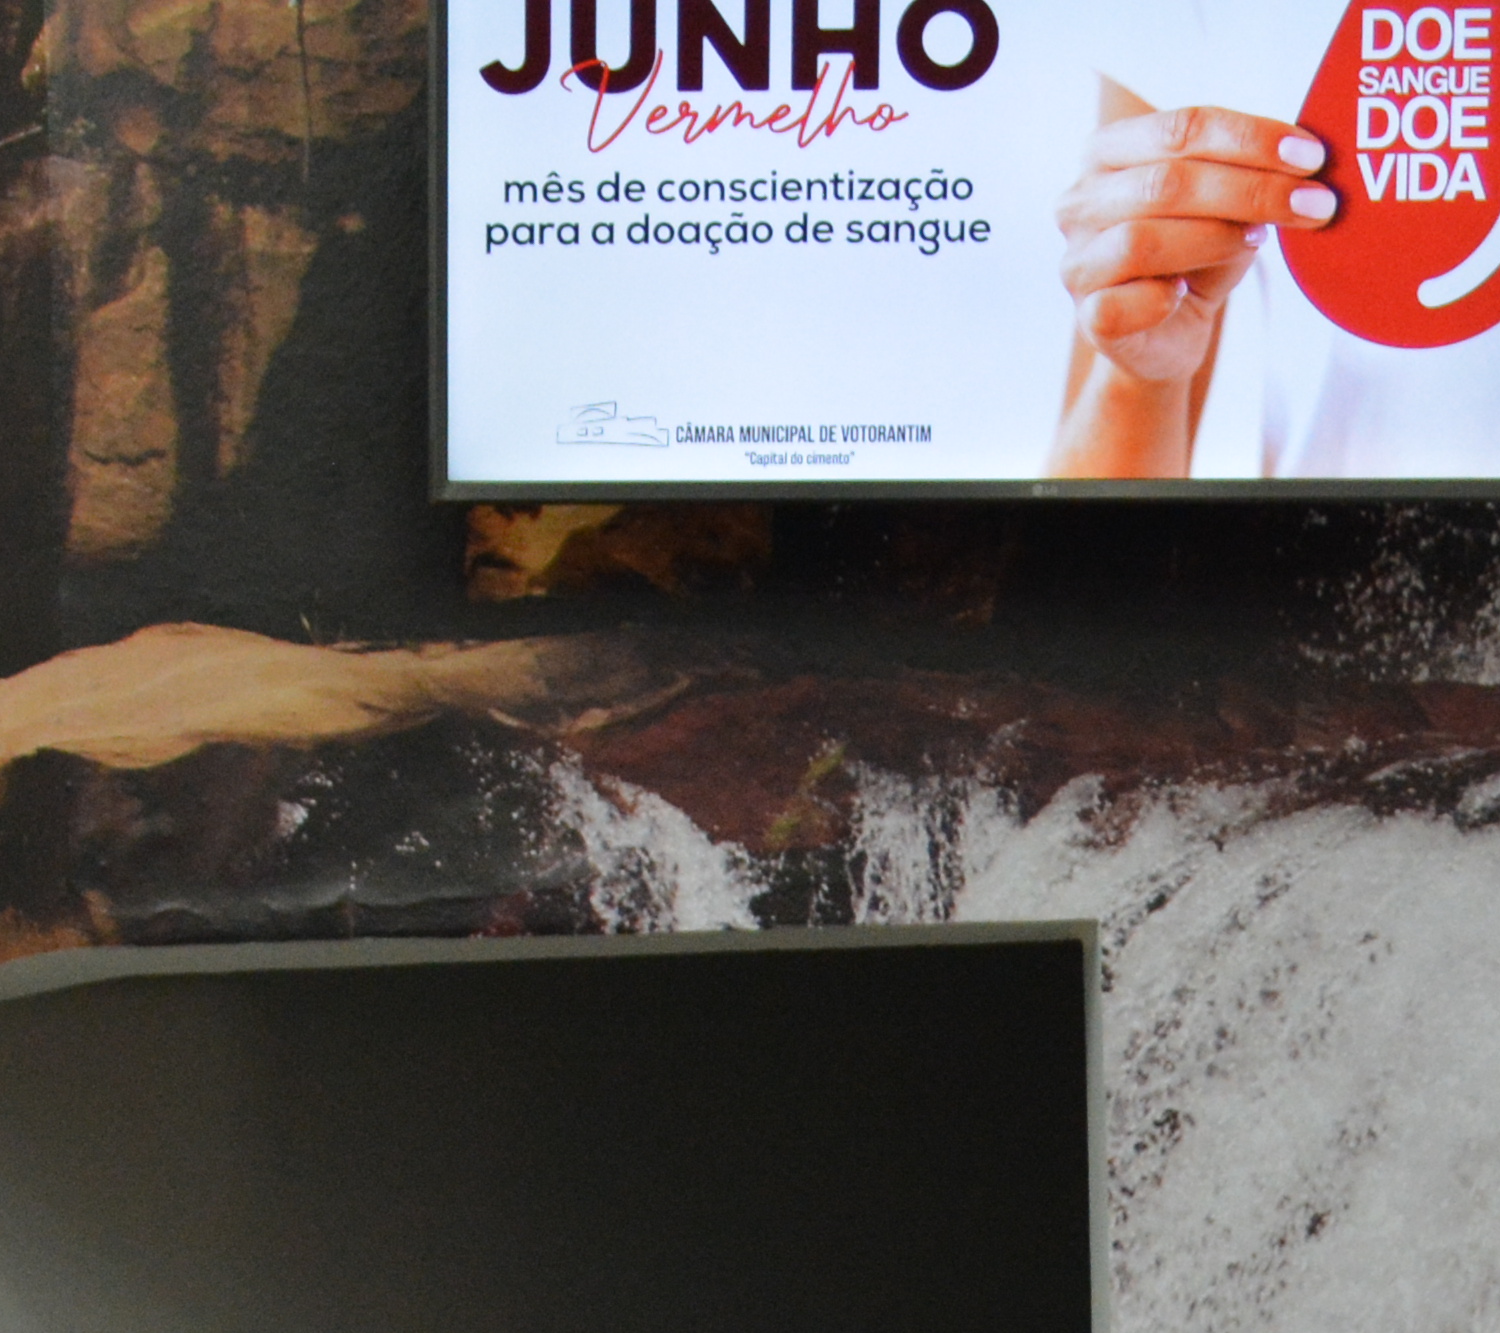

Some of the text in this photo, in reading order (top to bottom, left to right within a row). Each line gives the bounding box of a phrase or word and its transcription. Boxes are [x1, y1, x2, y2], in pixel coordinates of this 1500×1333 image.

[479, 0, 999, 94] JUNHO
[1361, 6, 1492, 61] DOE
[560, 49, 908, 152] Vermelho
[1358, 65, 1491, 95] SANGUE
[1356, 95, 1490, 150] DOE
[503, 168, 973, 211] mês de conscientização
[1355, 152, 1487, 201] VIDA
[486, 212, 991, 255] para a doação de sangue
[675, 421, 932, 443] CÂMARA MUNICIPAL DE VOTORANTIM
[790, 452, 803, 465] do
